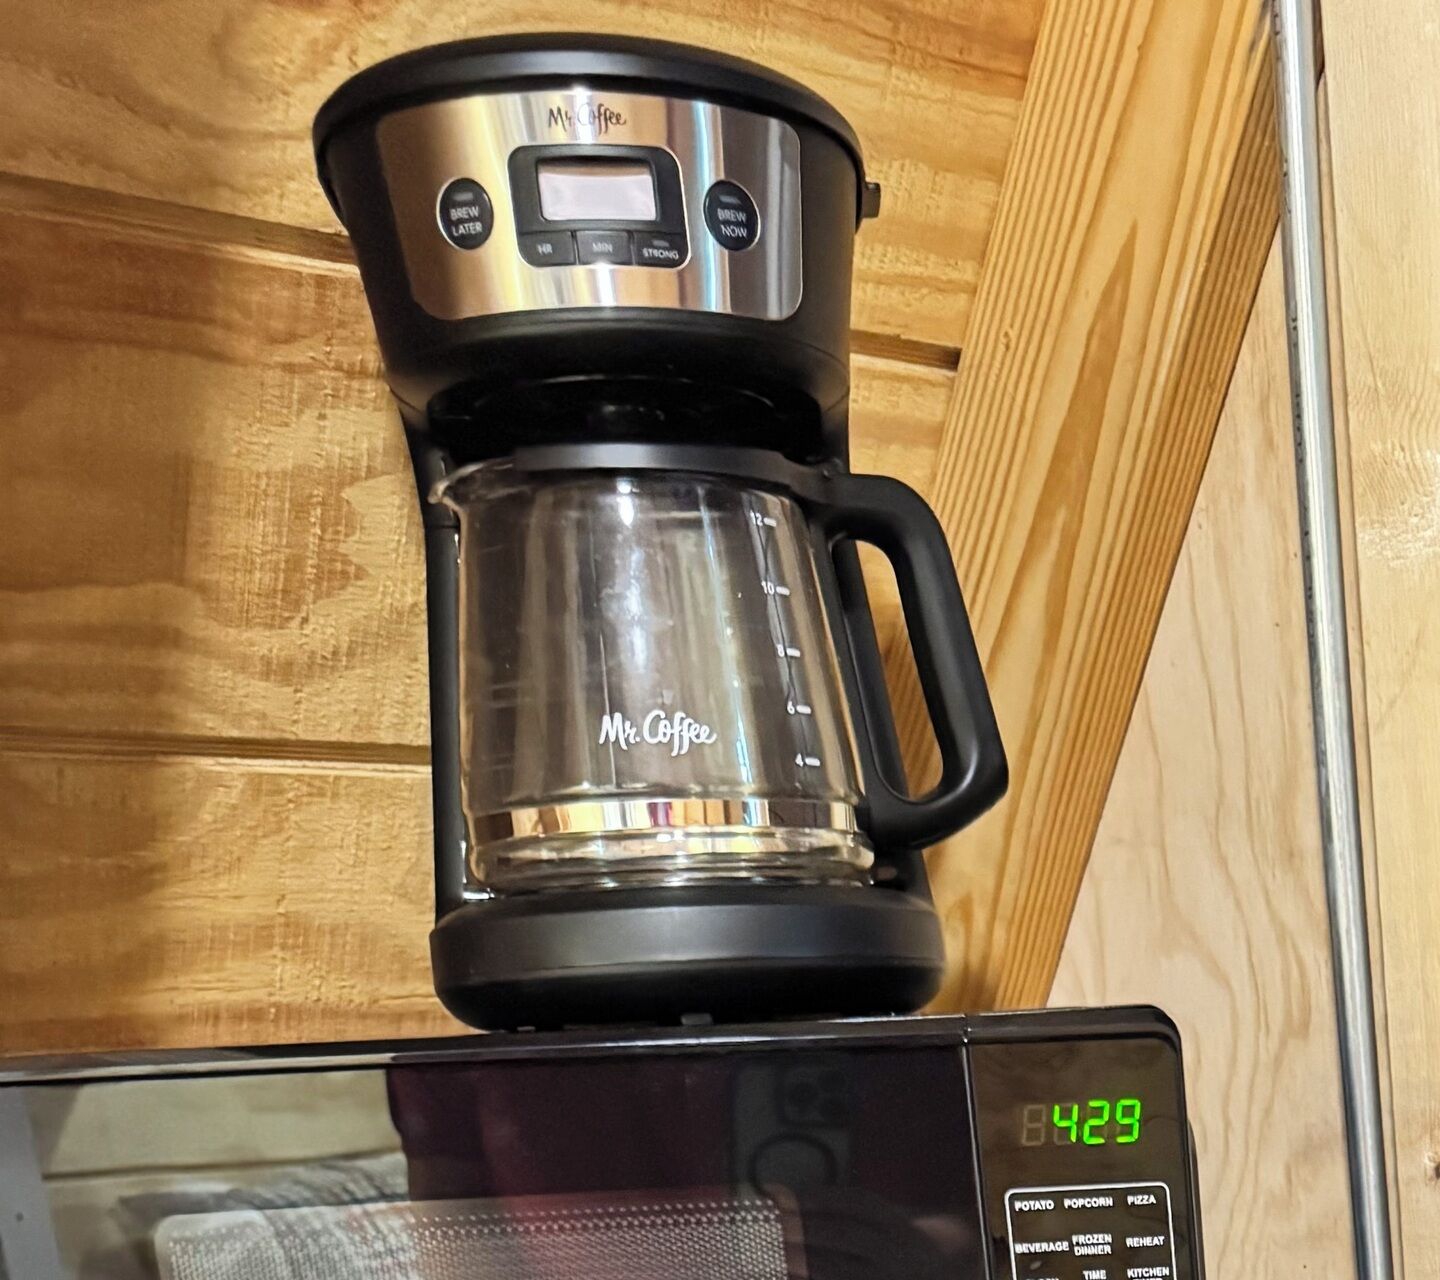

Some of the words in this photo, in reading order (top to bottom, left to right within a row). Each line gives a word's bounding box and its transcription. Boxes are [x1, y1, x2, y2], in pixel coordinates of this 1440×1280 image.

[577, 103, 627, 136] Coffee
[450, 206, 479, 220] BREW
[717, 208, 747, 223] BREW
[451, 221, 482, 236] LATER
[720, 224, 748, 238] NOW
[538, 243, 553, 254] HR
[642, 248, 679, 260] STRONG
[761, 581, 774, 594] 10
[787, 701, 796, 714] 6
[599, 712, 641, 750] Mr.
[643, 709, 717, 757] Coffee
[795, 753, 803, 767] 4
[1052, 1099, 1141, 1145] 429
[1014, 1199, 1055, 1212] POTATO
[1063, 1197, 1113, 1209] POPCORN
[1127, 1194, 1156, 1206] PIZZA
[1072, 1233, 1112, 1245] FROZEN
[1126, 1235, 1165, 1247] REHEAT
[1015, 1241, 1069, 1254] BEVERAGE
[1074, 1244, 1112, 1256] DINNER
[1082, 1270, 1107, 1280] TIME
[1127, 1267, 1170, 1279] KITCHEN
